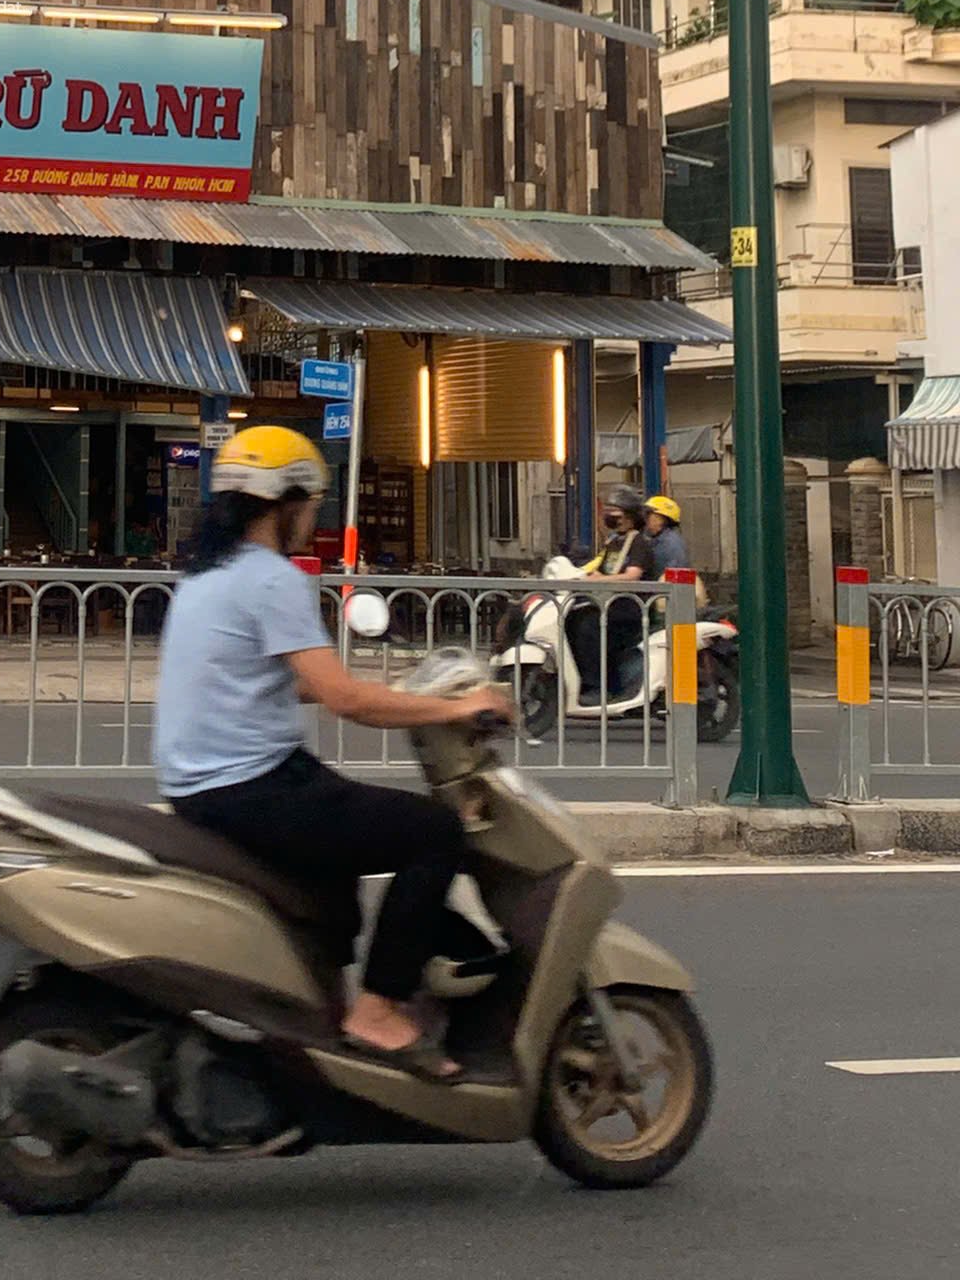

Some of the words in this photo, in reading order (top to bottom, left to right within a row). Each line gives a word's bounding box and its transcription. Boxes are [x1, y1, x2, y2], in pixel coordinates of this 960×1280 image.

[62, 79, 244, 140] DANH
[3, 168, 28, 183] 258
[184, 449, 200, 458] pep
